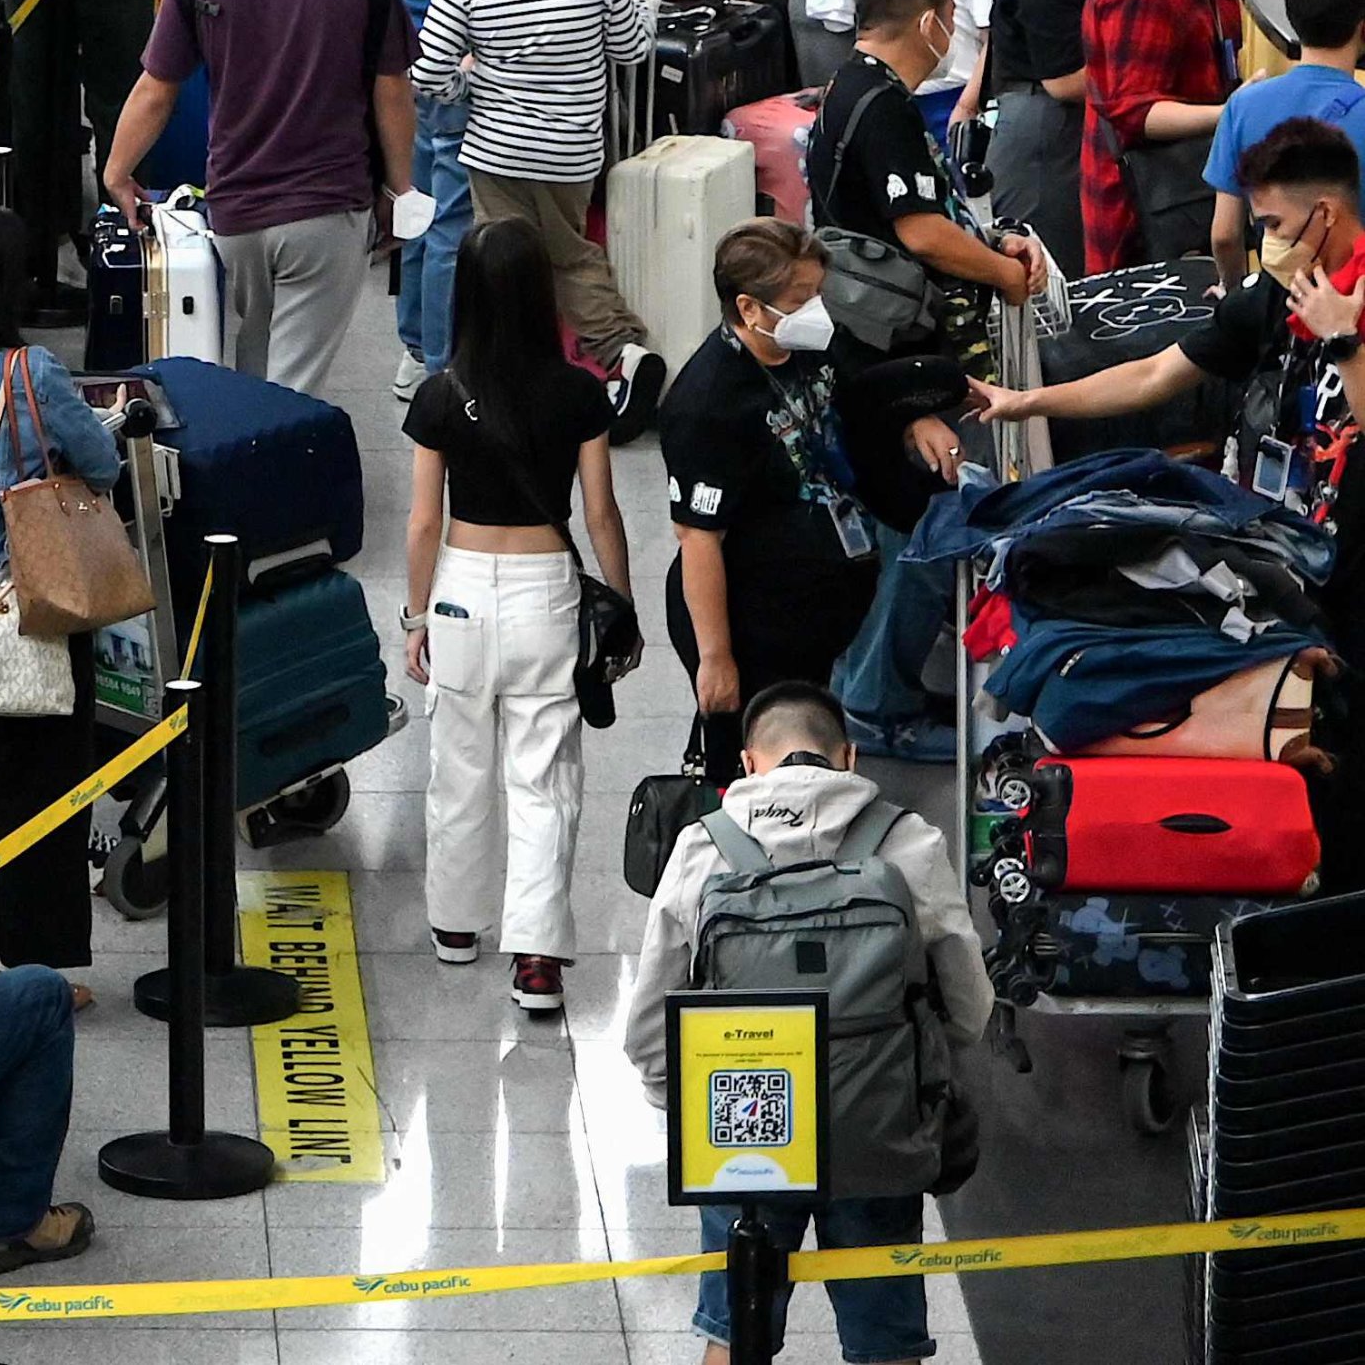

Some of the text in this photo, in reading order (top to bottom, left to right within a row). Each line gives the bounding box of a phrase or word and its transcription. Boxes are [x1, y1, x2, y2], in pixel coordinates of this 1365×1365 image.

[754, 802, 804, 828] Kuya
[724, 1028, 774, 1040] e-Travel
[279, 1024, 346, 1107] YELLOW
[1256, 1223, 1340, 1242] cebu pacific
[918, 1249, 1002, 1268] cebu pacific
[383, 1276, 471, 1294] cebu pacific
[25, 1295, 114, 1315] cebu pacific
